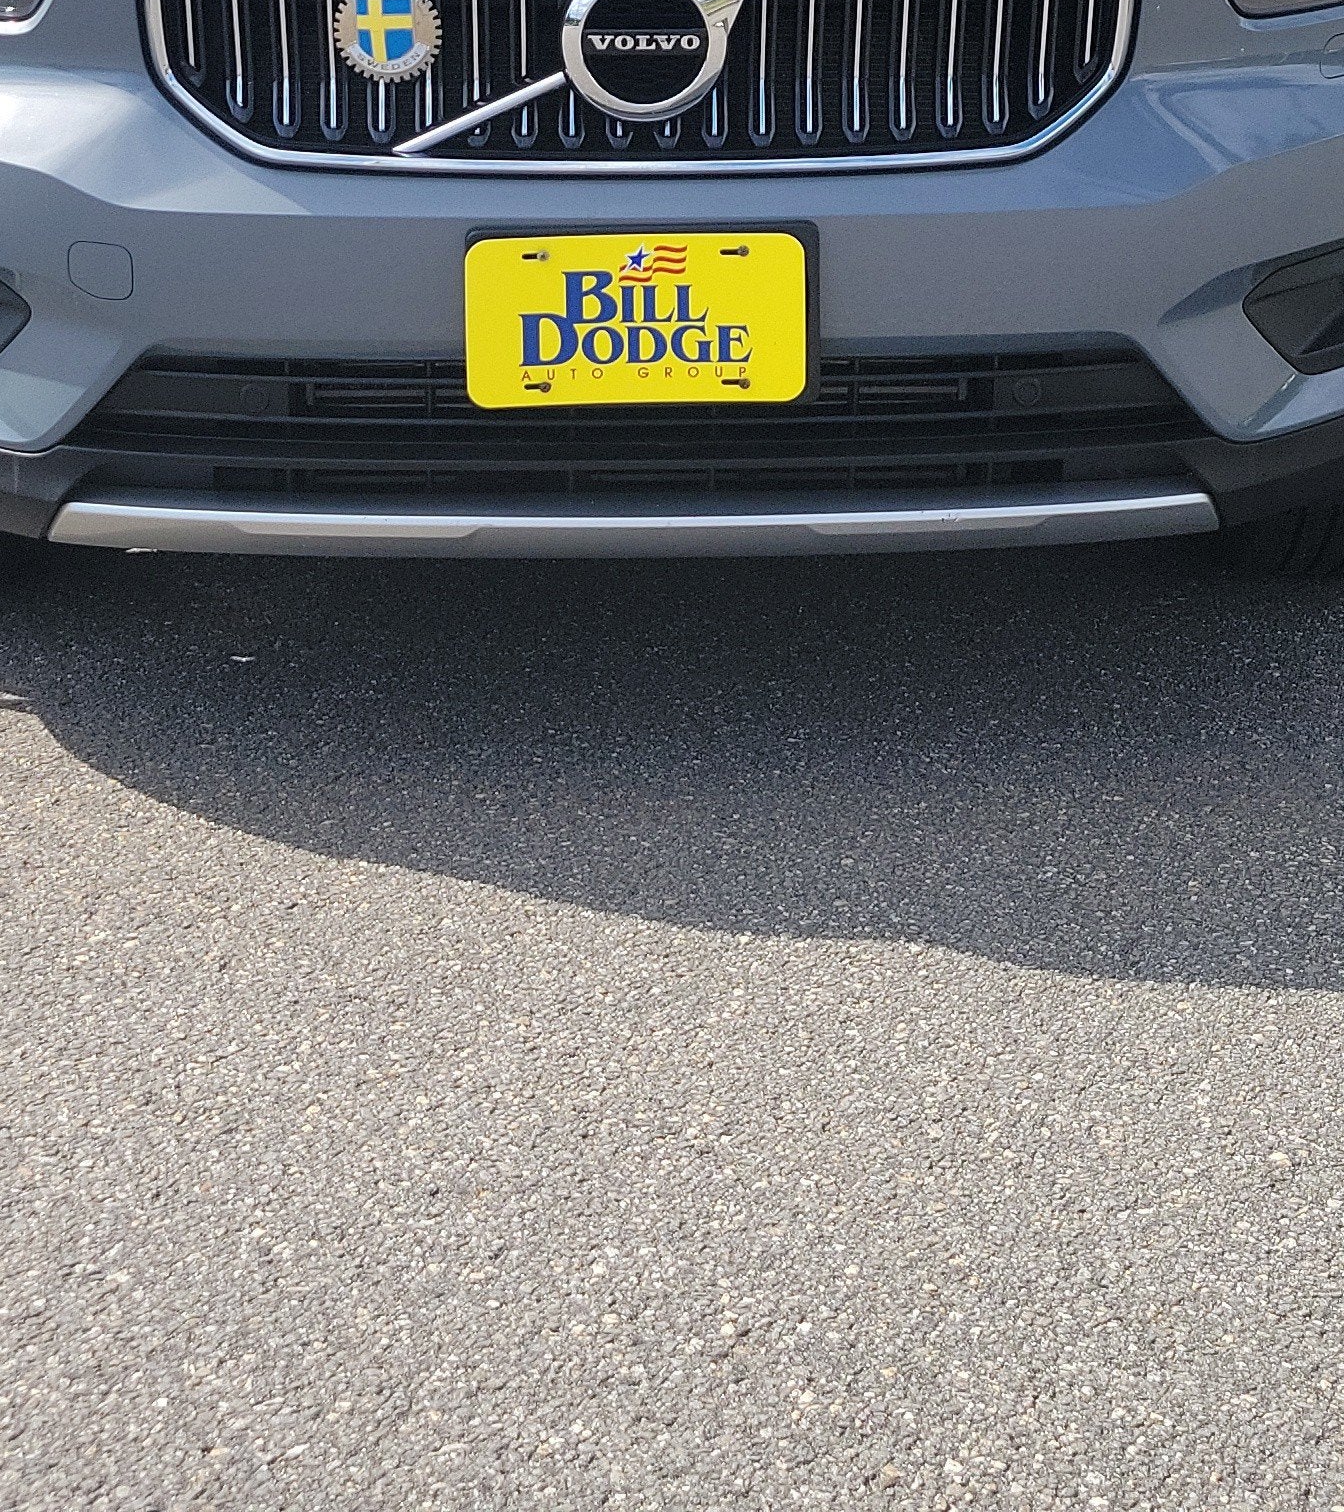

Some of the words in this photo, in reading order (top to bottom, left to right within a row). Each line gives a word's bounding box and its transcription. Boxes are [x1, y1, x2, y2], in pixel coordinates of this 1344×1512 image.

[587, 33, 701, 51] VOLVO
[356, 51, 421, 71] SWEDEN
[561, 270, 709, 324] BILL
[518, 312, 753, 368] DODGE
[520, 367, 605, 382] AUTO
[637, 365, 748, 380] GROUP
